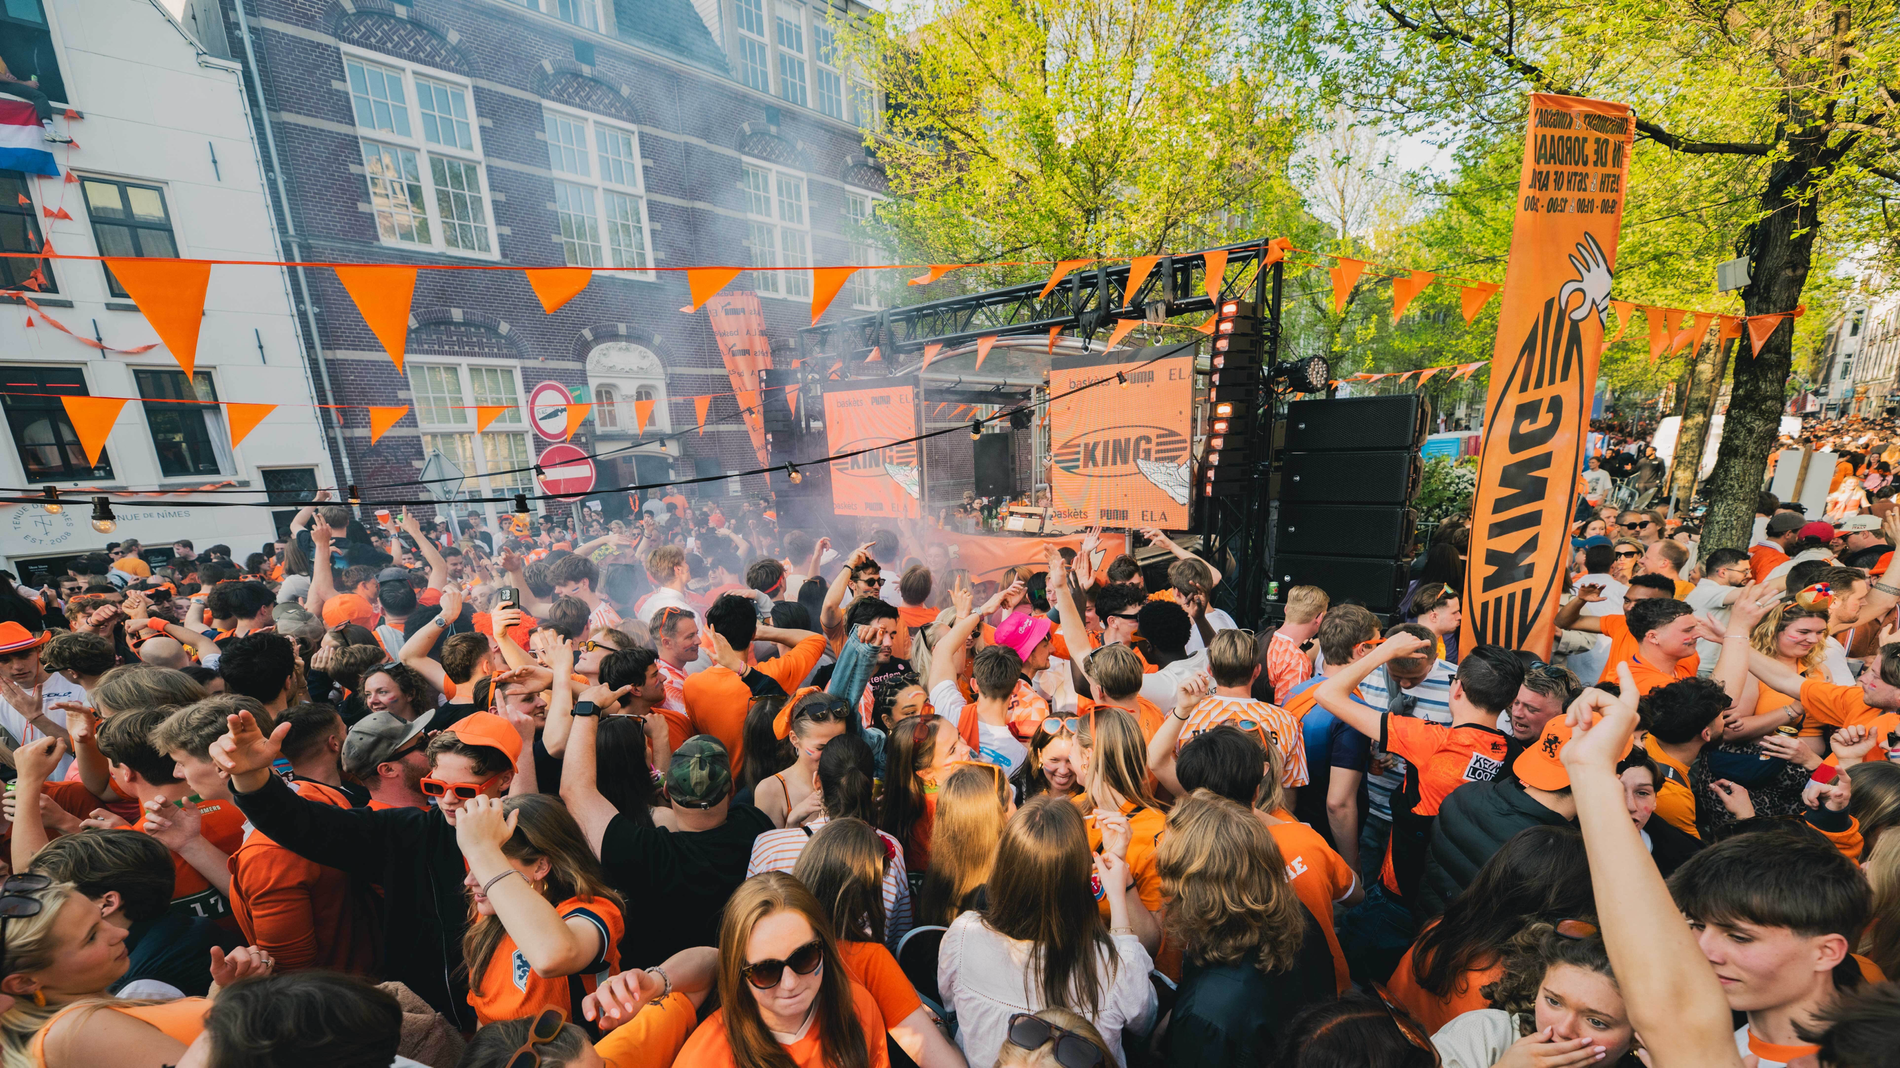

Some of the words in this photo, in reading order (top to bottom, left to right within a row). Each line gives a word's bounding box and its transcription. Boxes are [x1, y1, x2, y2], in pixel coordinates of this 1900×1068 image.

[871, 395, 891, 406] PUMA
[899, 394, 914, 404] EL
[850, 446, 895, 470] KING
[1082, 435, 1153, 469] KING
[12, 505, 29, 531] TENUE
[60, 511, 74, 527] MES
[116, 513, 141, 521] NUE
[156, 509, 191, 519] NÎMES
[1100, 509, 1129, 521] PUMA
[1141, 510, 1168, 522] ELA
[870, 671, 901, 684] terdam
[190, 894, 224, 917] 17
